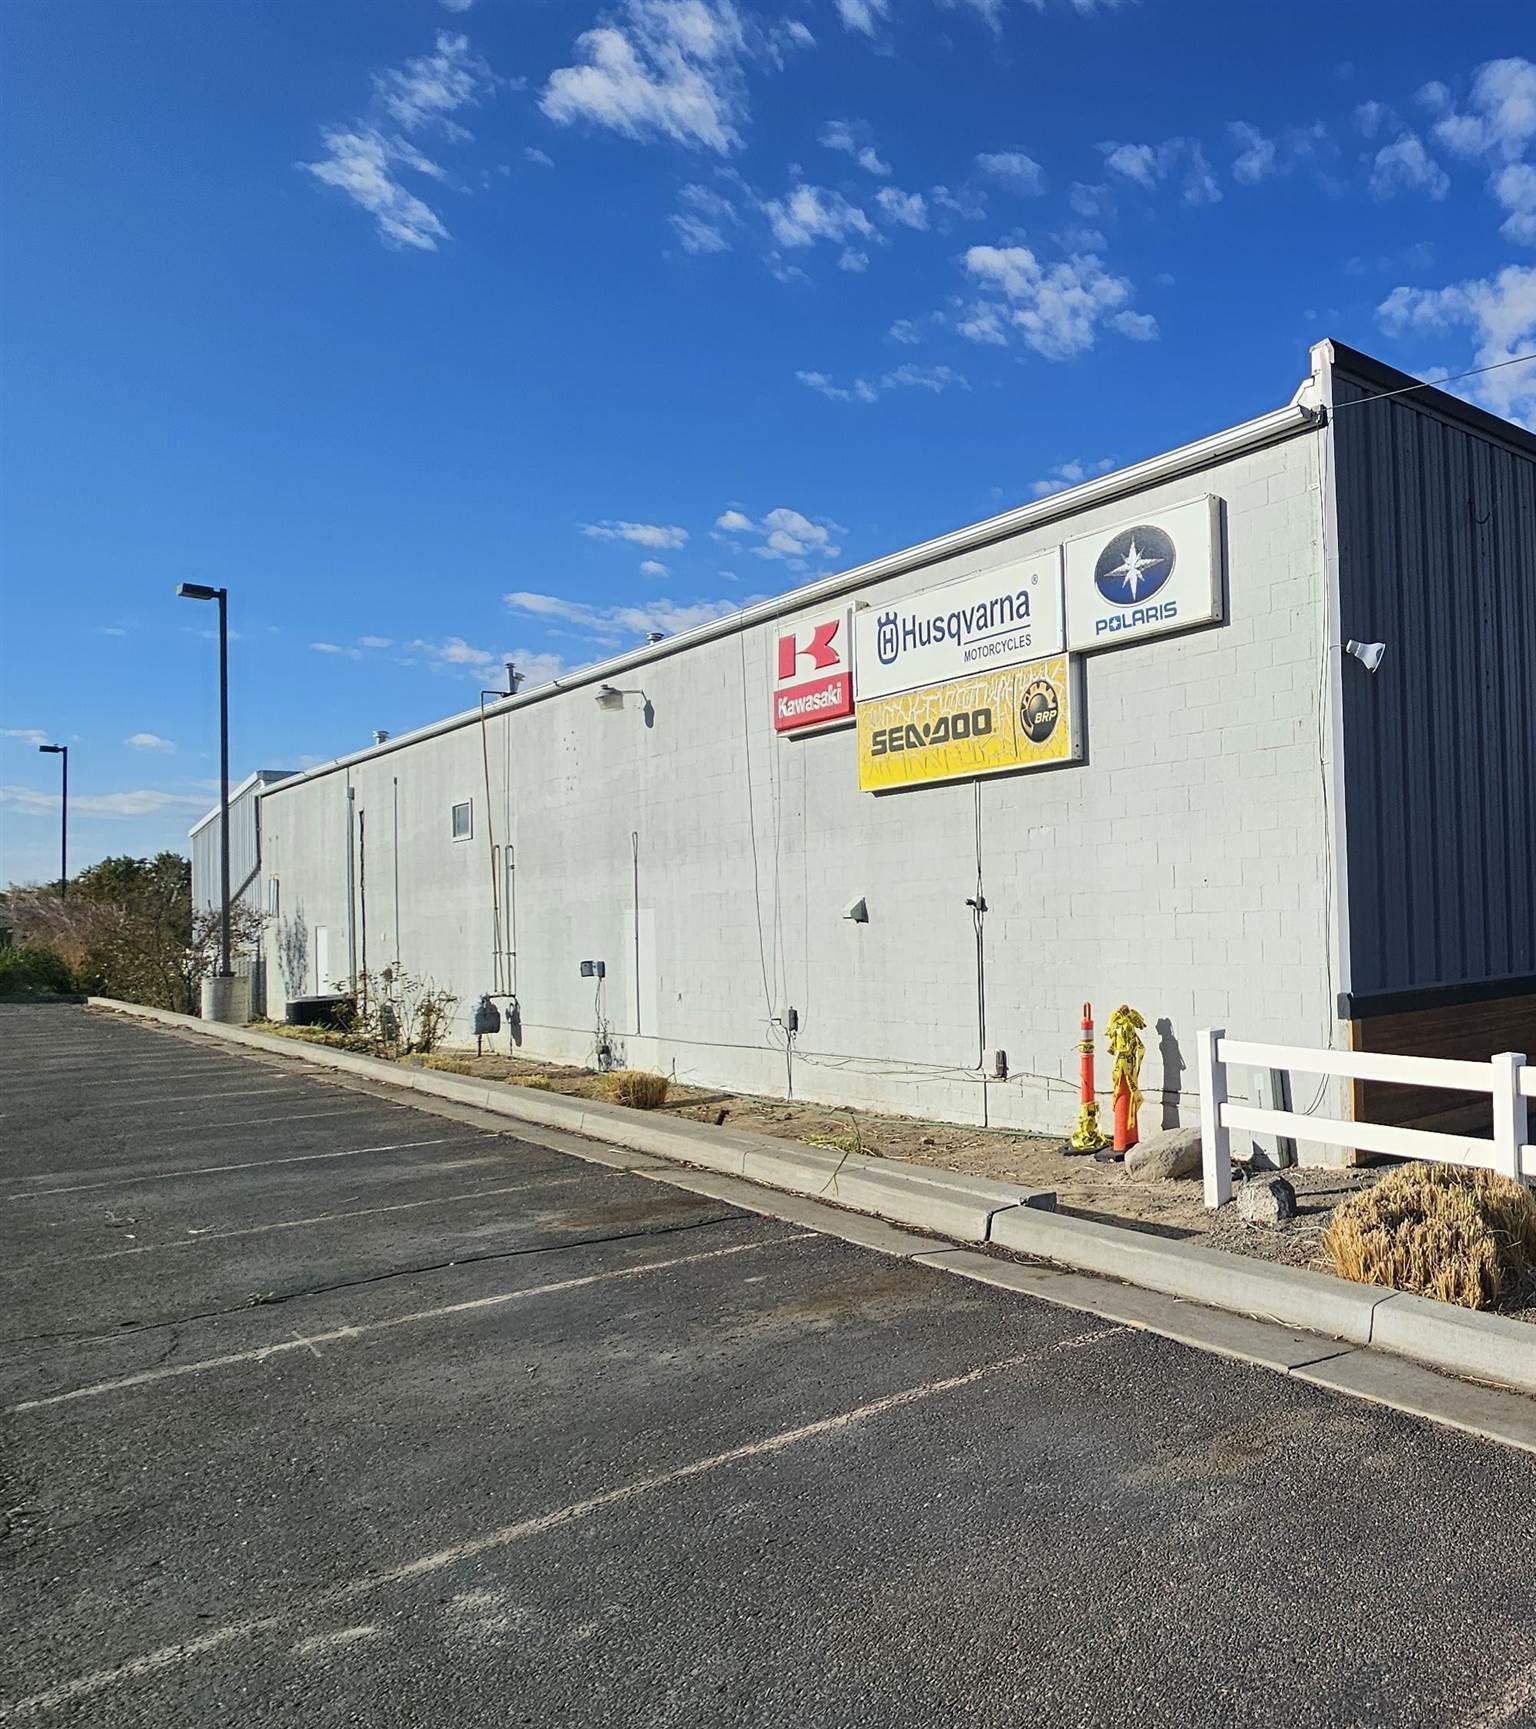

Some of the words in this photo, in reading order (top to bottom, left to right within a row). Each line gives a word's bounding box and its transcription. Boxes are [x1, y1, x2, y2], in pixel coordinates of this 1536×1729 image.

[902, 590, 1031, 651] Husqvarna
[1096, 601, 1177, 635] POLARIS
[964, 634, 1032, 663] MOTORCYCLES
[778, 682, 842, 718] Kawasaki
[1034, 710, 1057, 723] BRP
